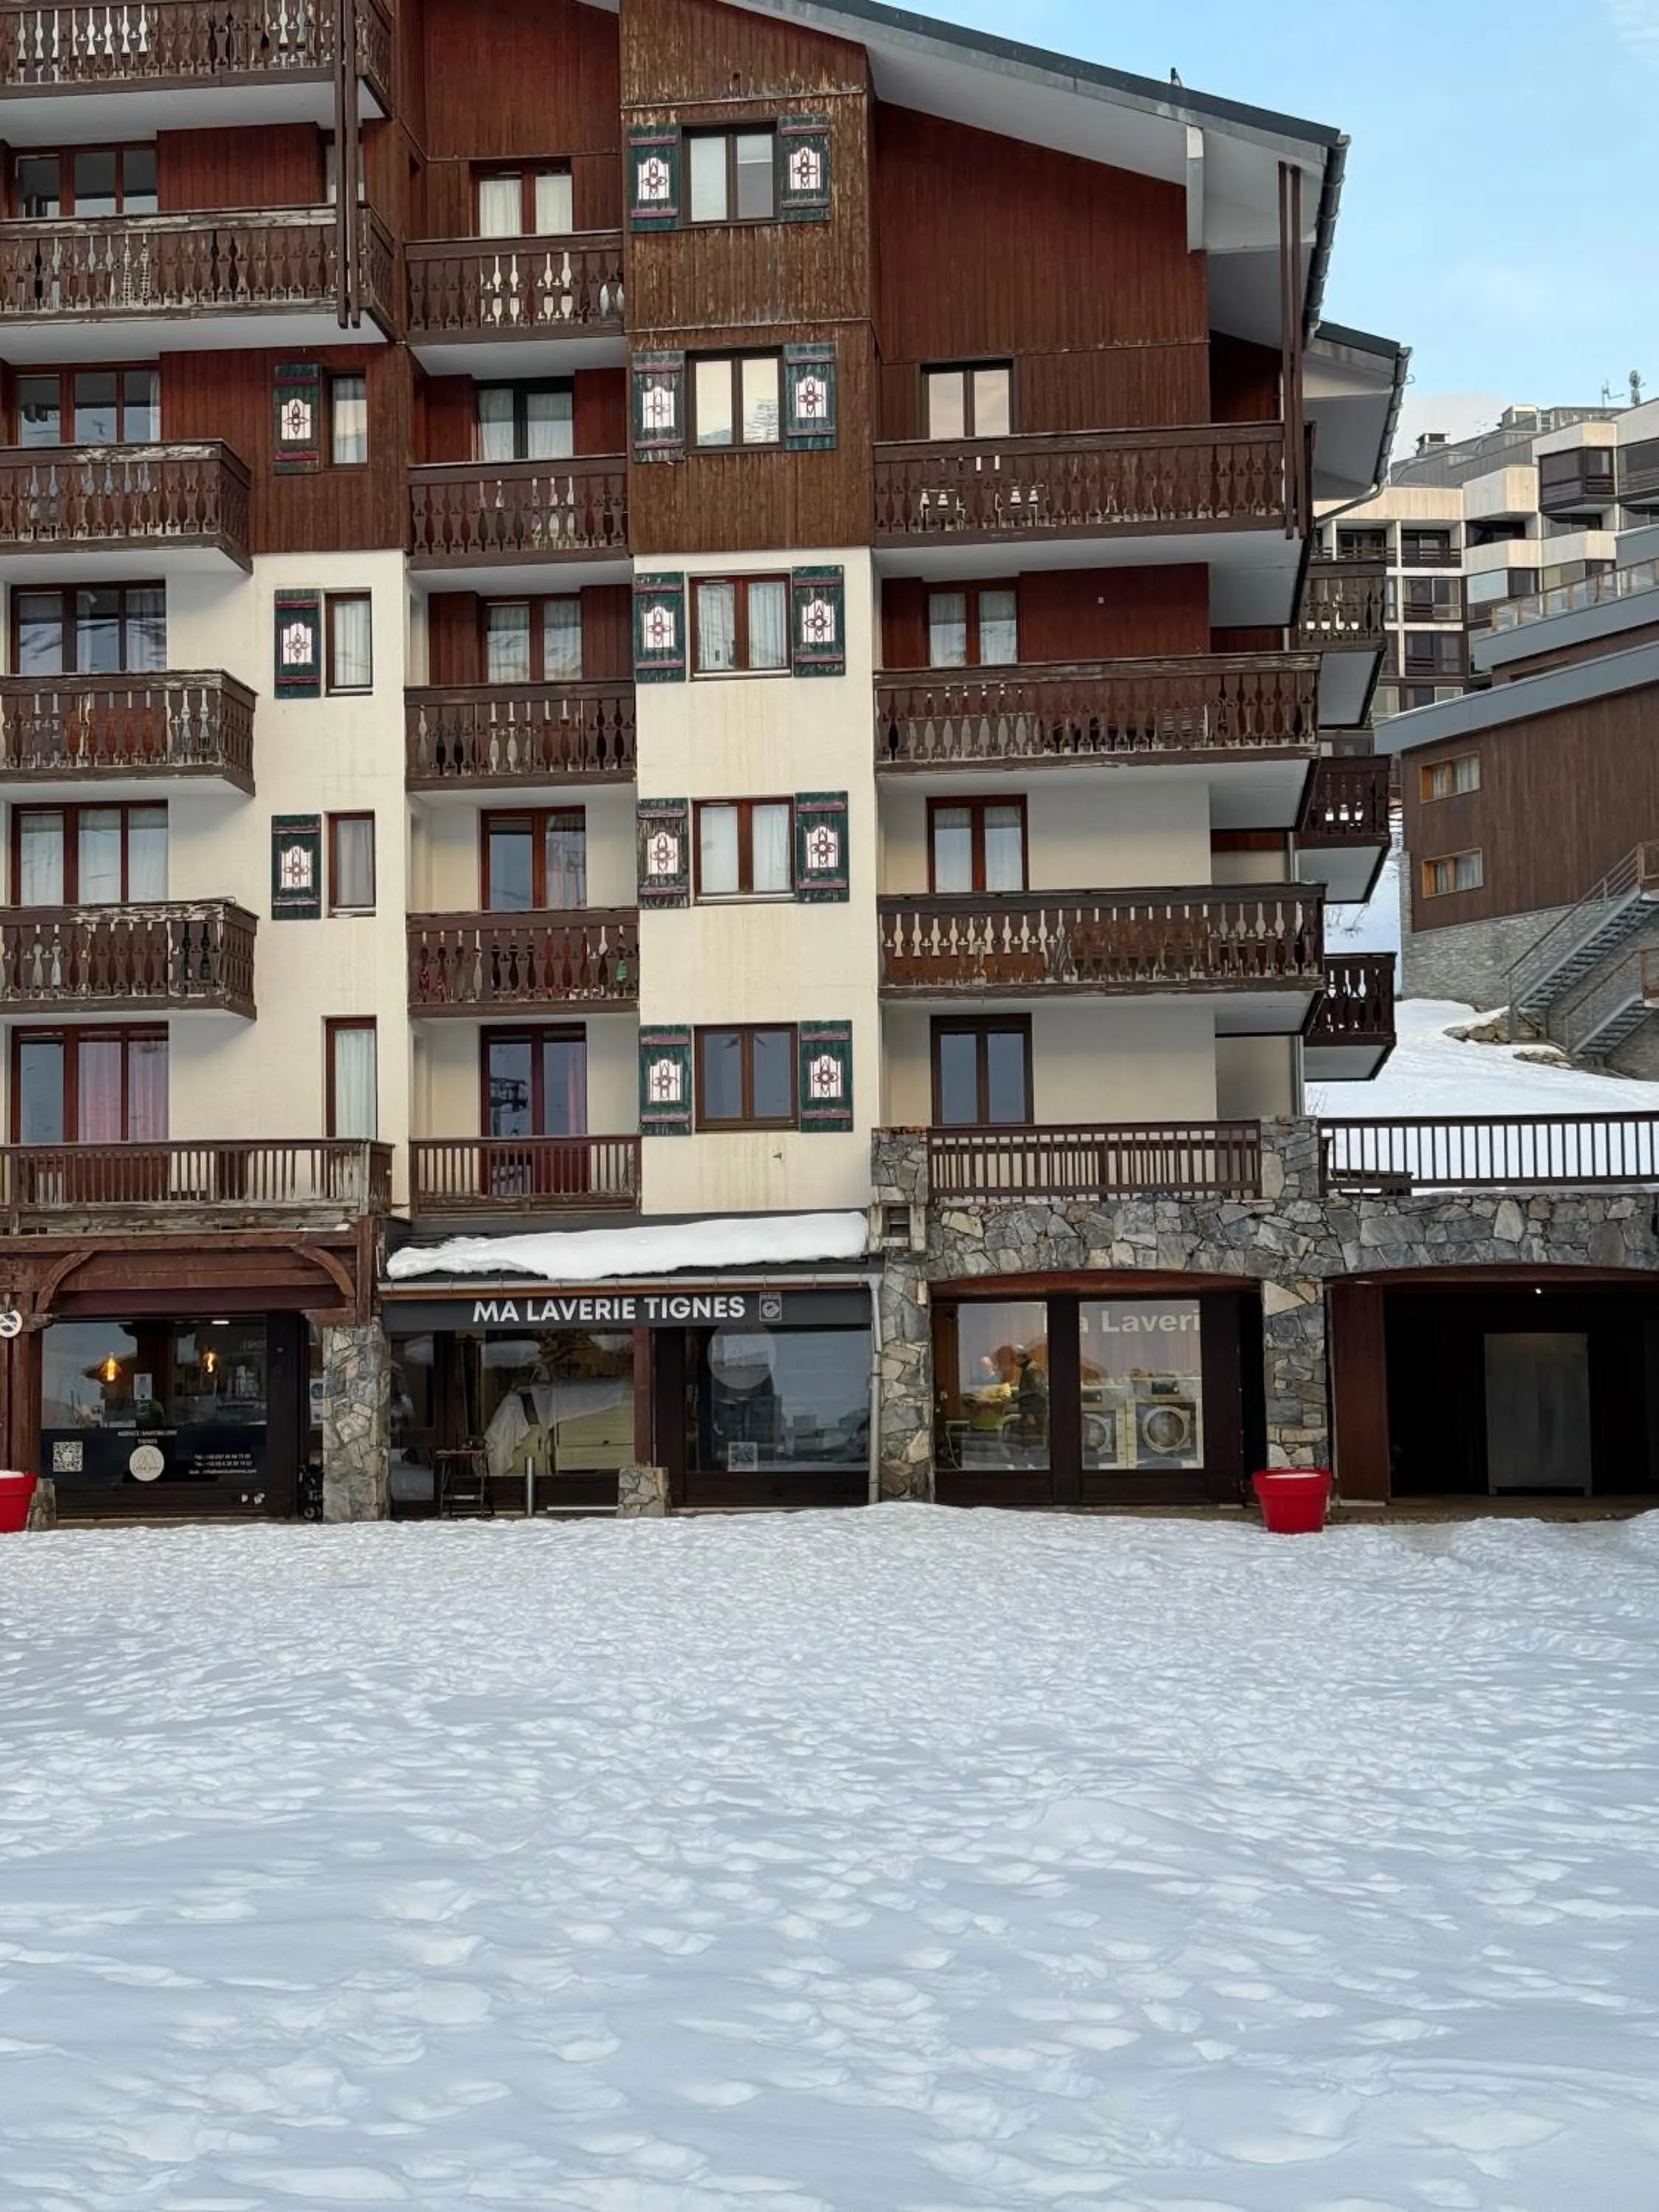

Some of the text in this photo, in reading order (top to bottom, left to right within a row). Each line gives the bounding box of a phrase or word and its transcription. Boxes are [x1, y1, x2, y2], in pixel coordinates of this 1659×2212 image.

[473, 1295, 745, 1322] MA LAVERIE TIGNES
